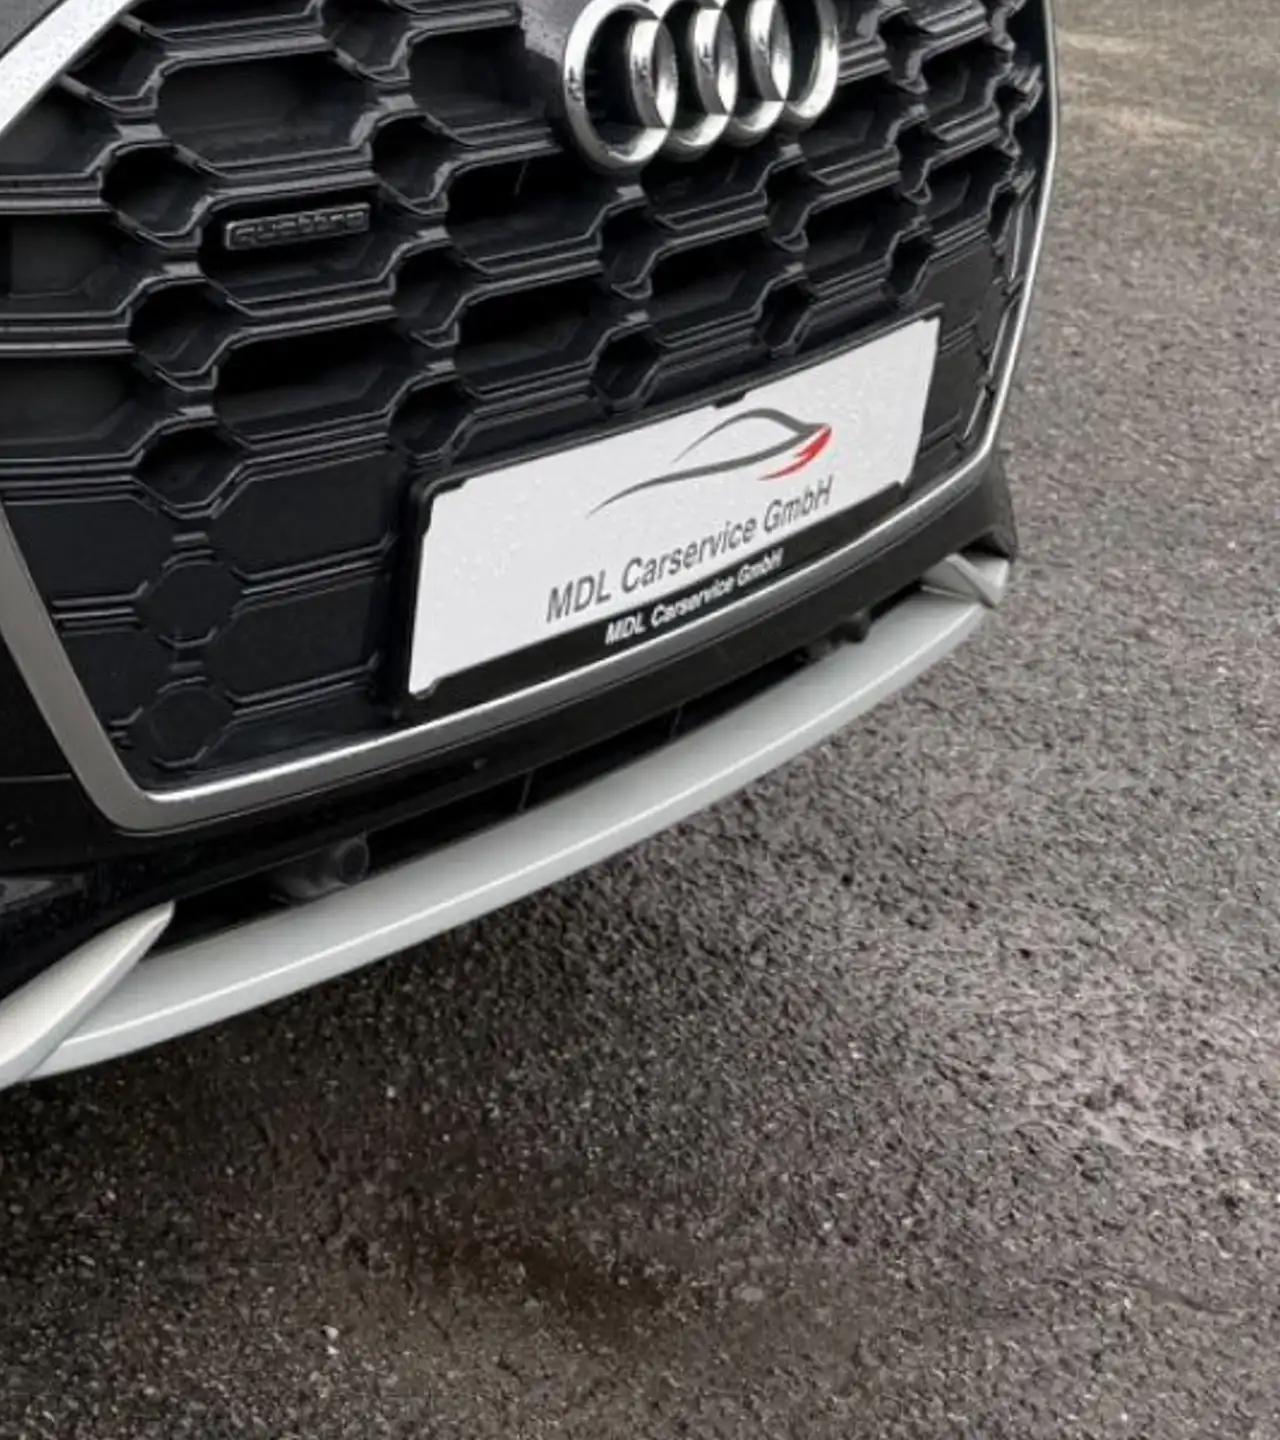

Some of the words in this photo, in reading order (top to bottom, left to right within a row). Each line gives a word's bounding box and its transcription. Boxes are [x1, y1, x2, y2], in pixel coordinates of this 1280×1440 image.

[546, 570, 611, 623] MDL
[621, 516, 757, 593] Carservice
[763, 475, 834, 536] GmbH
[605, 614, 645, 647] MDL
[650, 578, 734, 630] Carservice
[738, 548, 784, 589] GmbH
